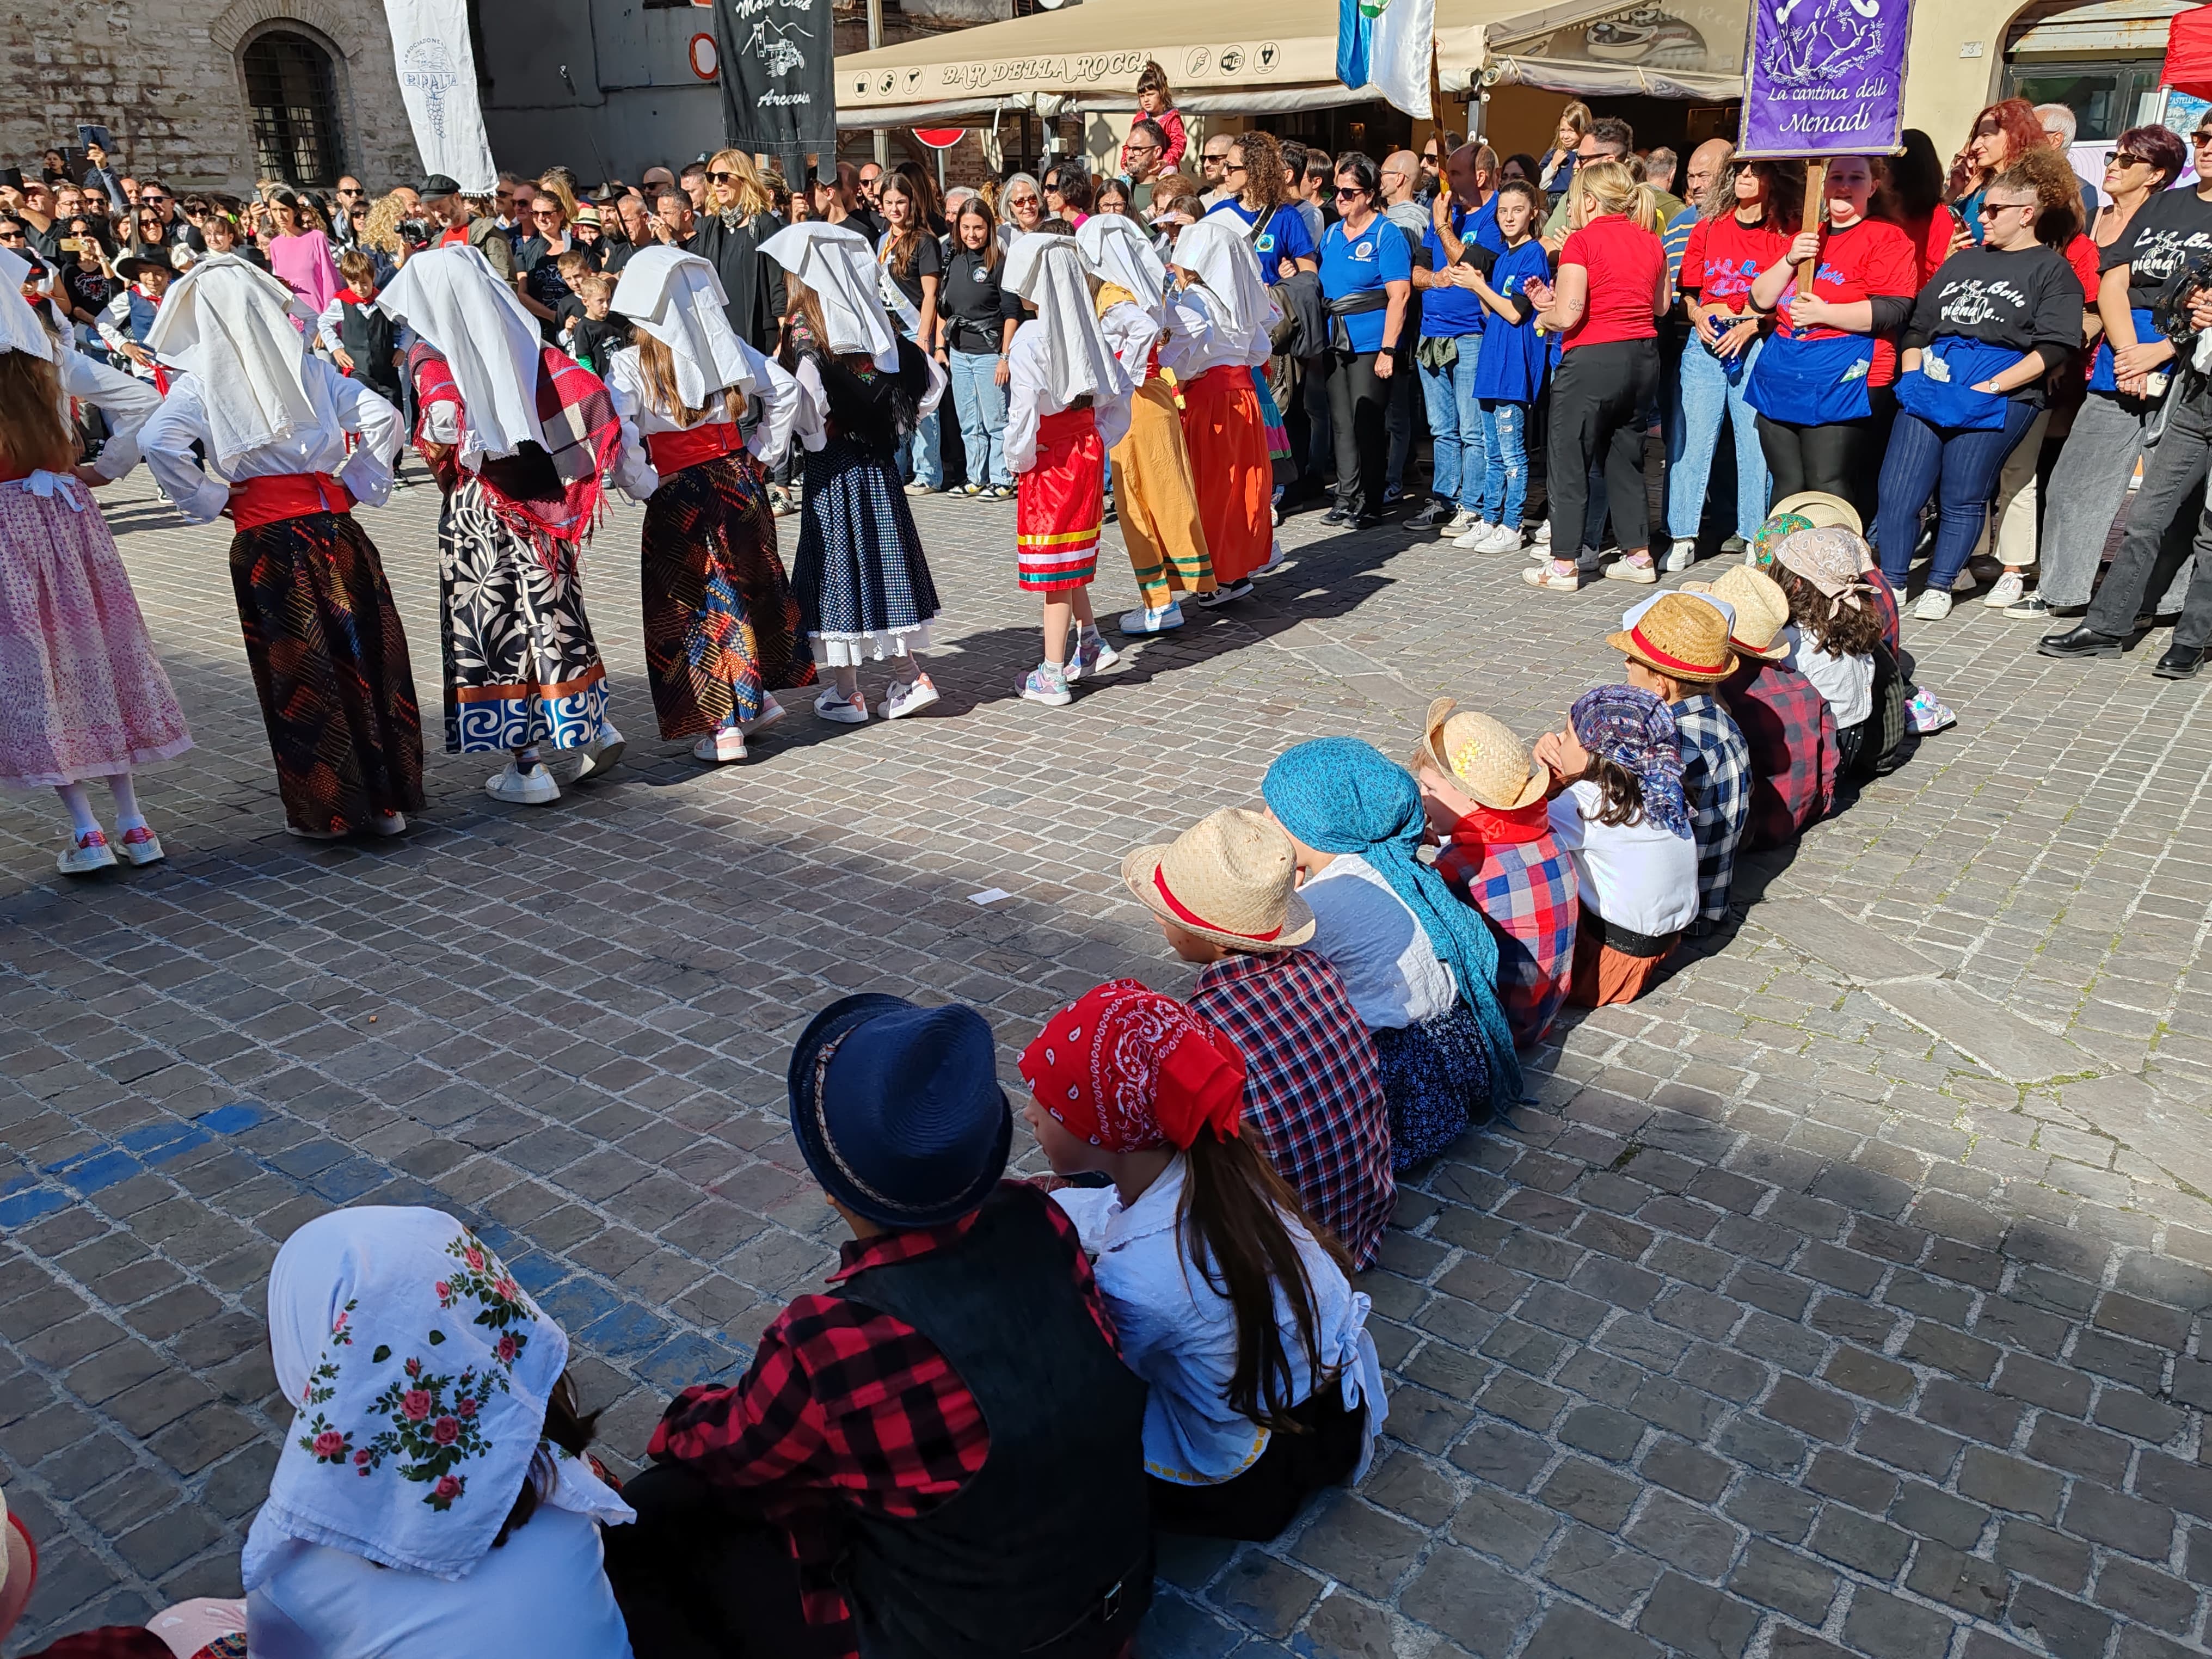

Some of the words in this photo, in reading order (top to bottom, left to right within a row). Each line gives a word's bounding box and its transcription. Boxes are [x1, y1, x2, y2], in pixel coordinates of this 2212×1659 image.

[1968, 44, 1976, 54] 3
[942, 63, 991, 90] BAR
[991, 58, 1078, 84] DELLA
[1077, 52, 1152, 82] ROCCA
[1768, 88, 1787, 101] La
[1779, 102, 1875, 132] Menadi
[2131, 255, 2174, 275] piena
[1938, 281, 1959, 299] La
[1987, 281, 2026, 308] Botte
[1941, 302, 1978, 321] piena
